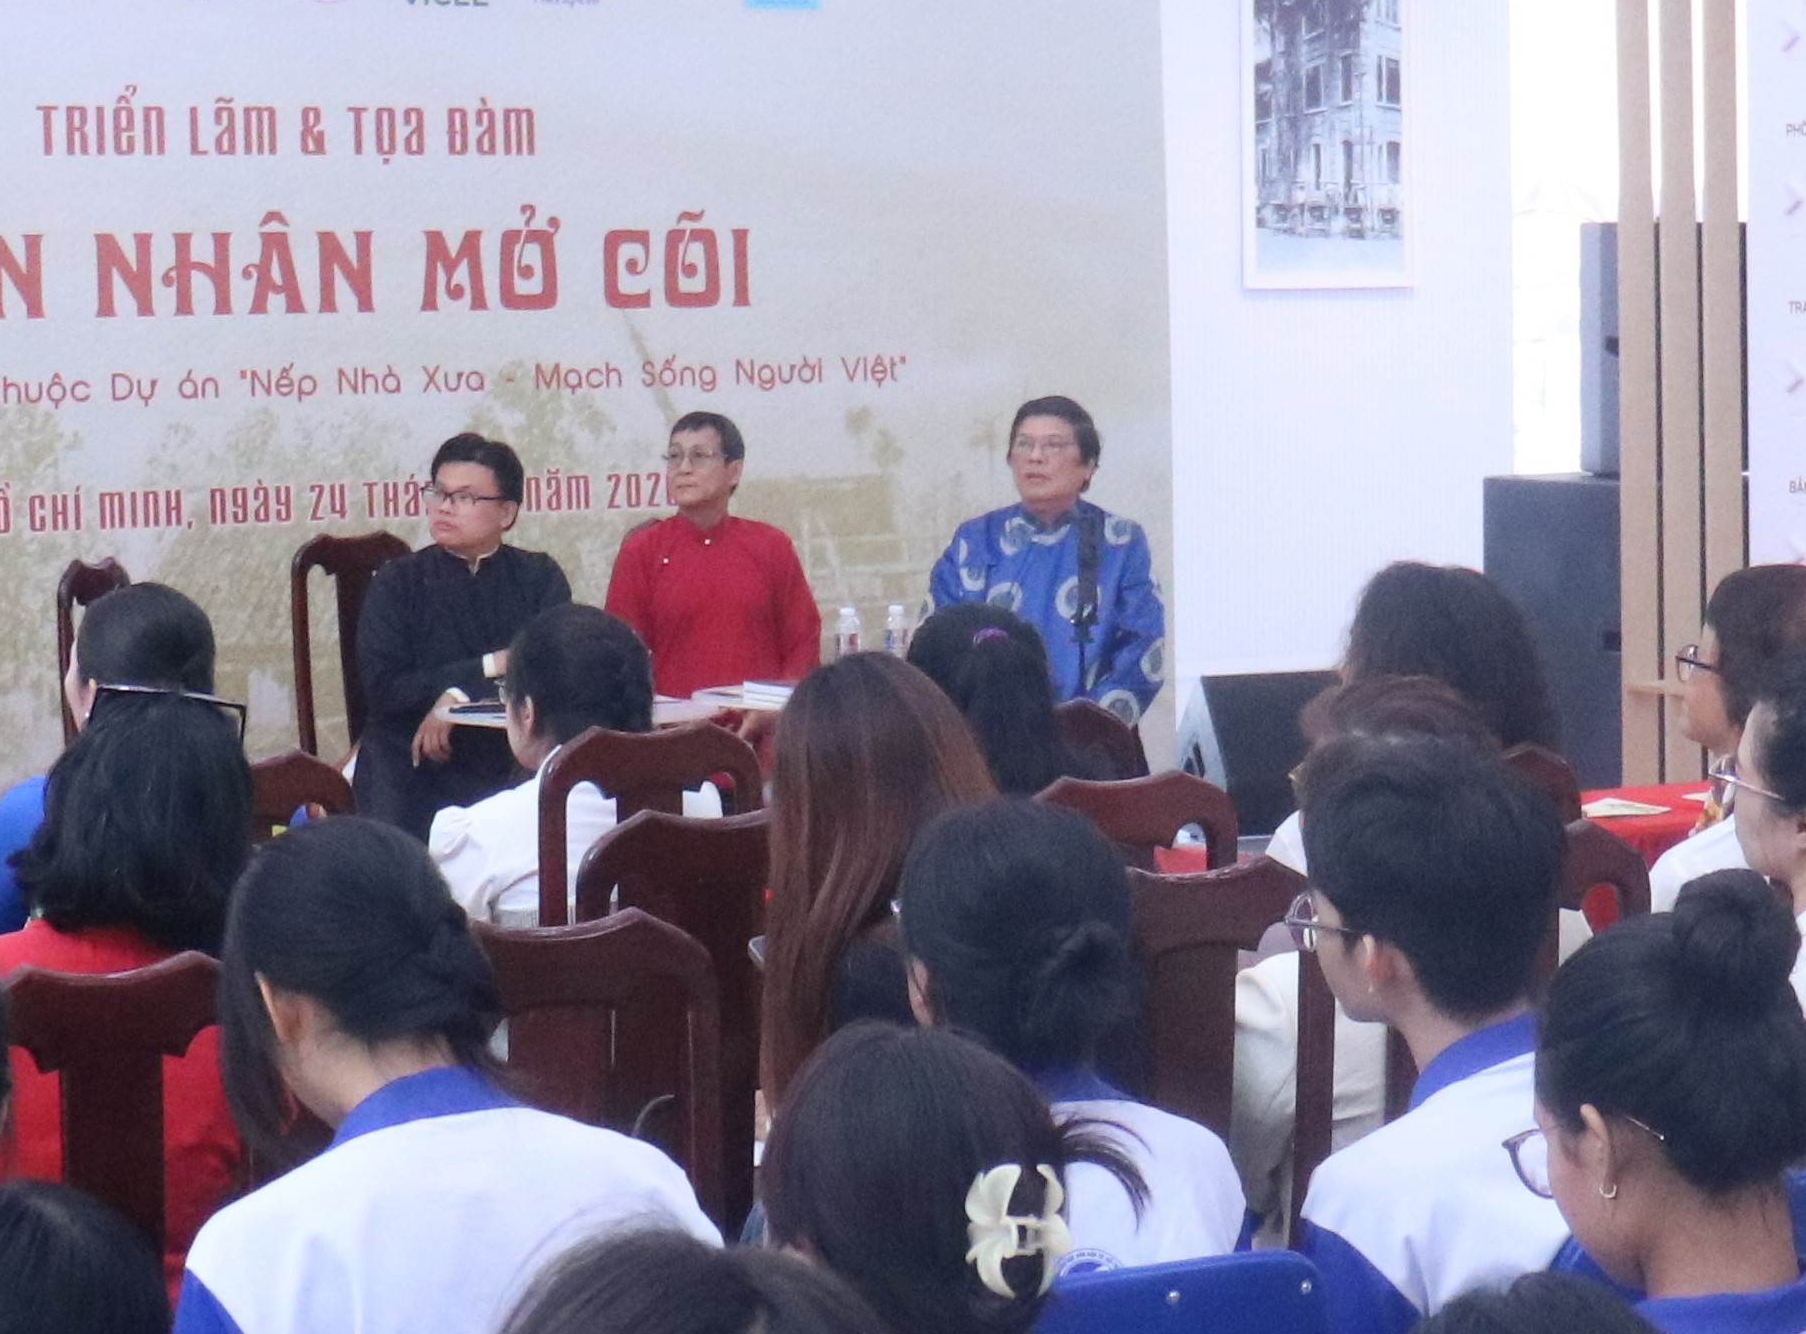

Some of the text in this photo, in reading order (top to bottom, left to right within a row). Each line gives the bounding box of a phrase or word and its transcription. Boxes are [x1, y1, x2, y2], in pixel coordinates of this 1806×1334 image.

[301, 107, 326, 156] &
[94, 211, 374, 317] NHÂN
[420, 204, 560, 312] MỞ
[603, 209, 751, 309] CÕI
[111, 373, 157, 406] Dự
[178, 369, 219, 402] án
[336, 365, 401, 394] Nhà
[422, 365, 485, 393] Xưa
[535, 361, 622, 394] Mạch
[642, 354, 717, 392] Sống
[735, 355, 822, 390] Người
[28, 486, 82, 533] CHÍ
[309, 483, 347, 522] 24
[363, 473, 432, 519] THÁ
[607, 471, 677, 510] 202
